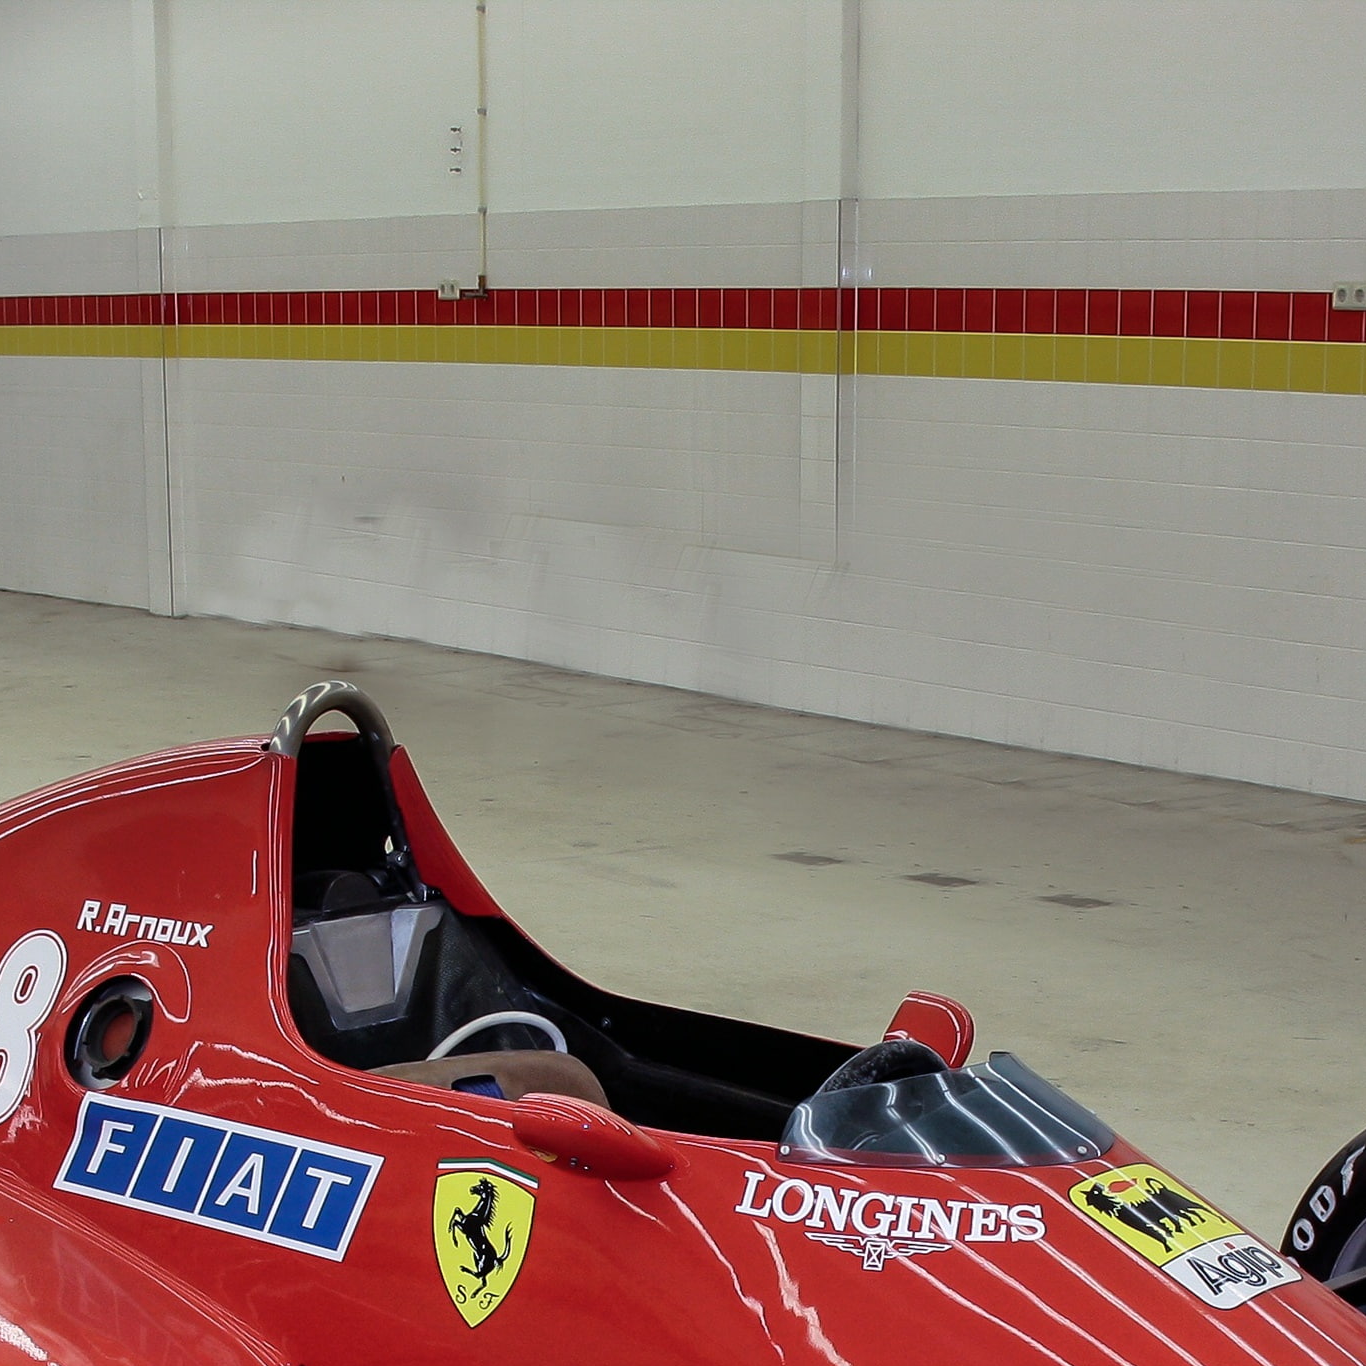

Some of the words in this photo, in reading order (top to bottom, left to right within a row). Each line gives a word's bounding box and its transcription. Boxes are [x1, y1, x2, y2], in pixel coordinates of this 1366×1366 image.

[76, 899, 214, 948] R.Arnoux
[85, 1119, 353, 1229] FIAT
[734, 1171, 1046, 1243] LONGINES
[455, 1284, 468, 1305] S
[1186, 1241, 1285, 1296] Agip
